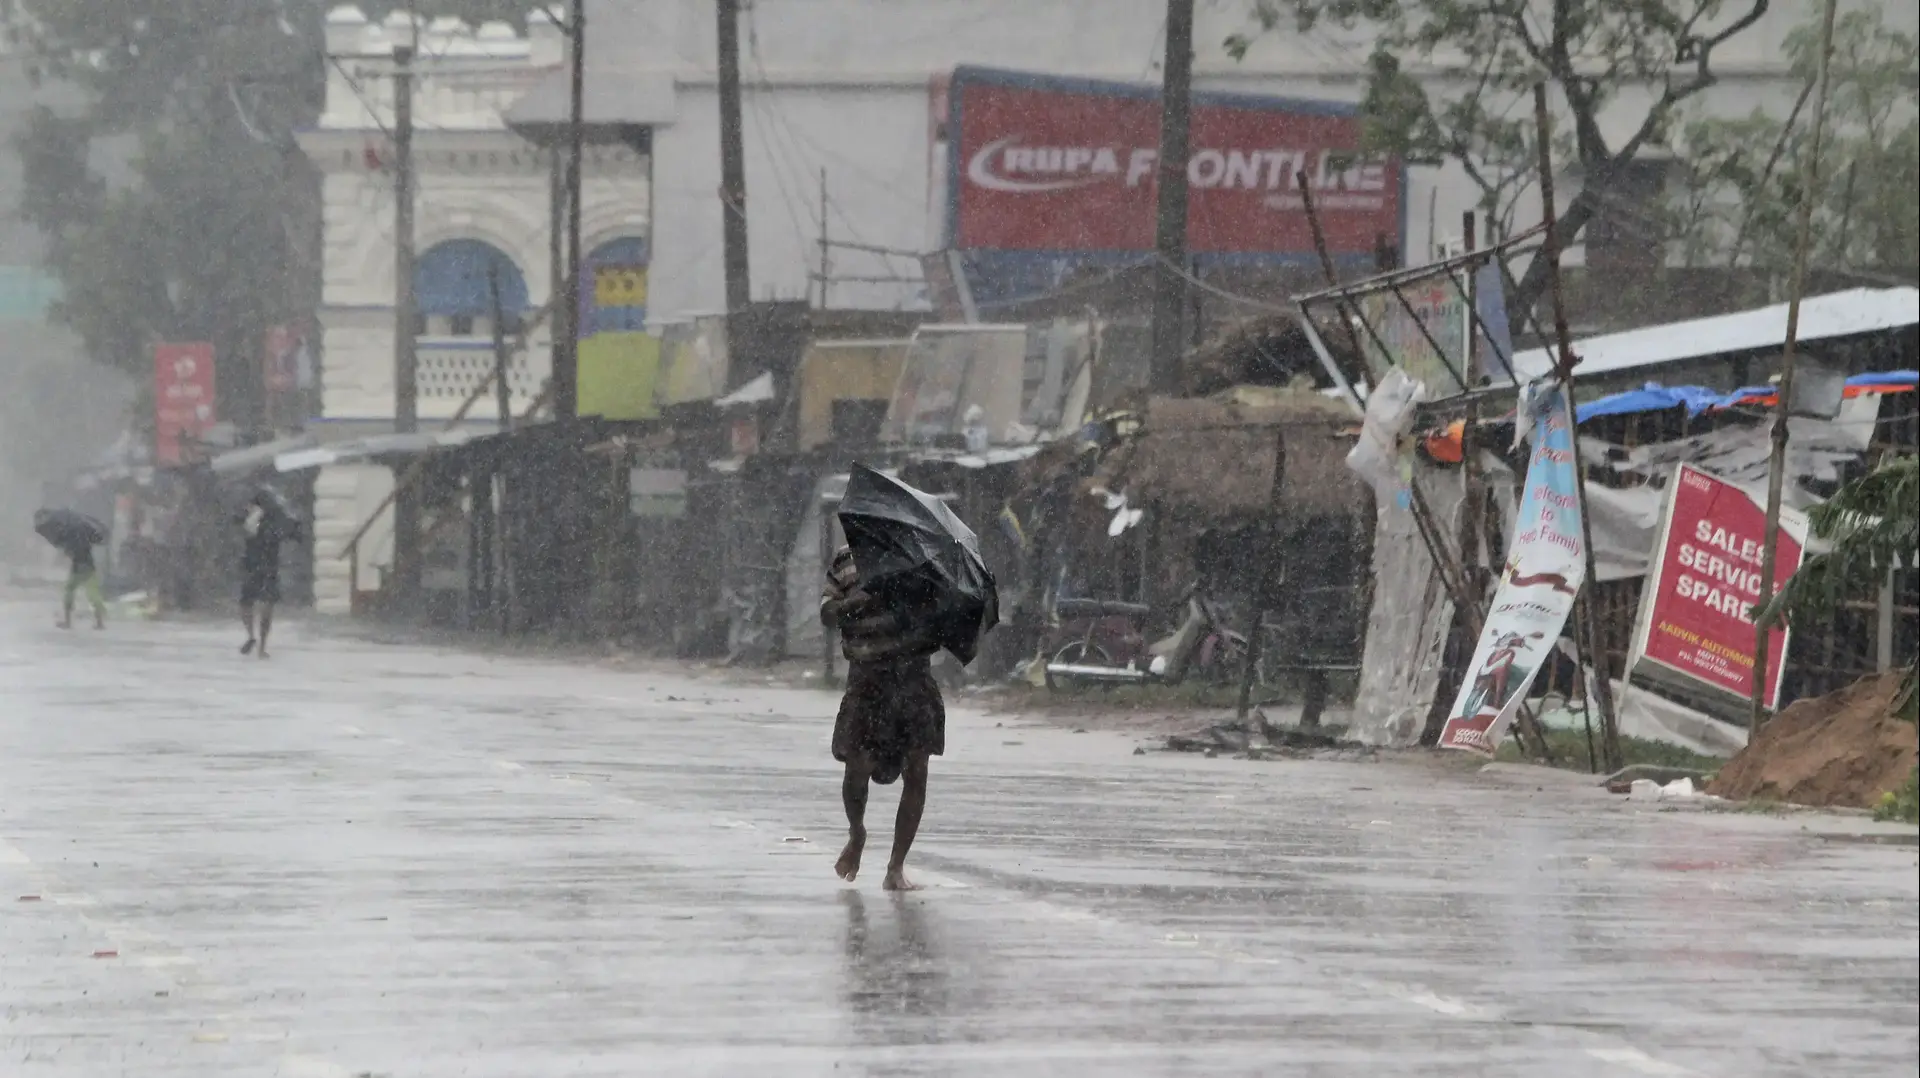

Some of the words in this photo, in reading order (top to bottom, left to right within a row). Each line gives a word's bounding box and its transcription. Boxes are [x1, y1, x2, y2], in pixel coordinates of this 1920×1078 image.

[1003, 147, 1119, 174] RUPA
[1126, 148, 1389, 191] FONTLINE
[1541, 505, 1555, 521] to
[1540, 524, 1580, 556] Family
